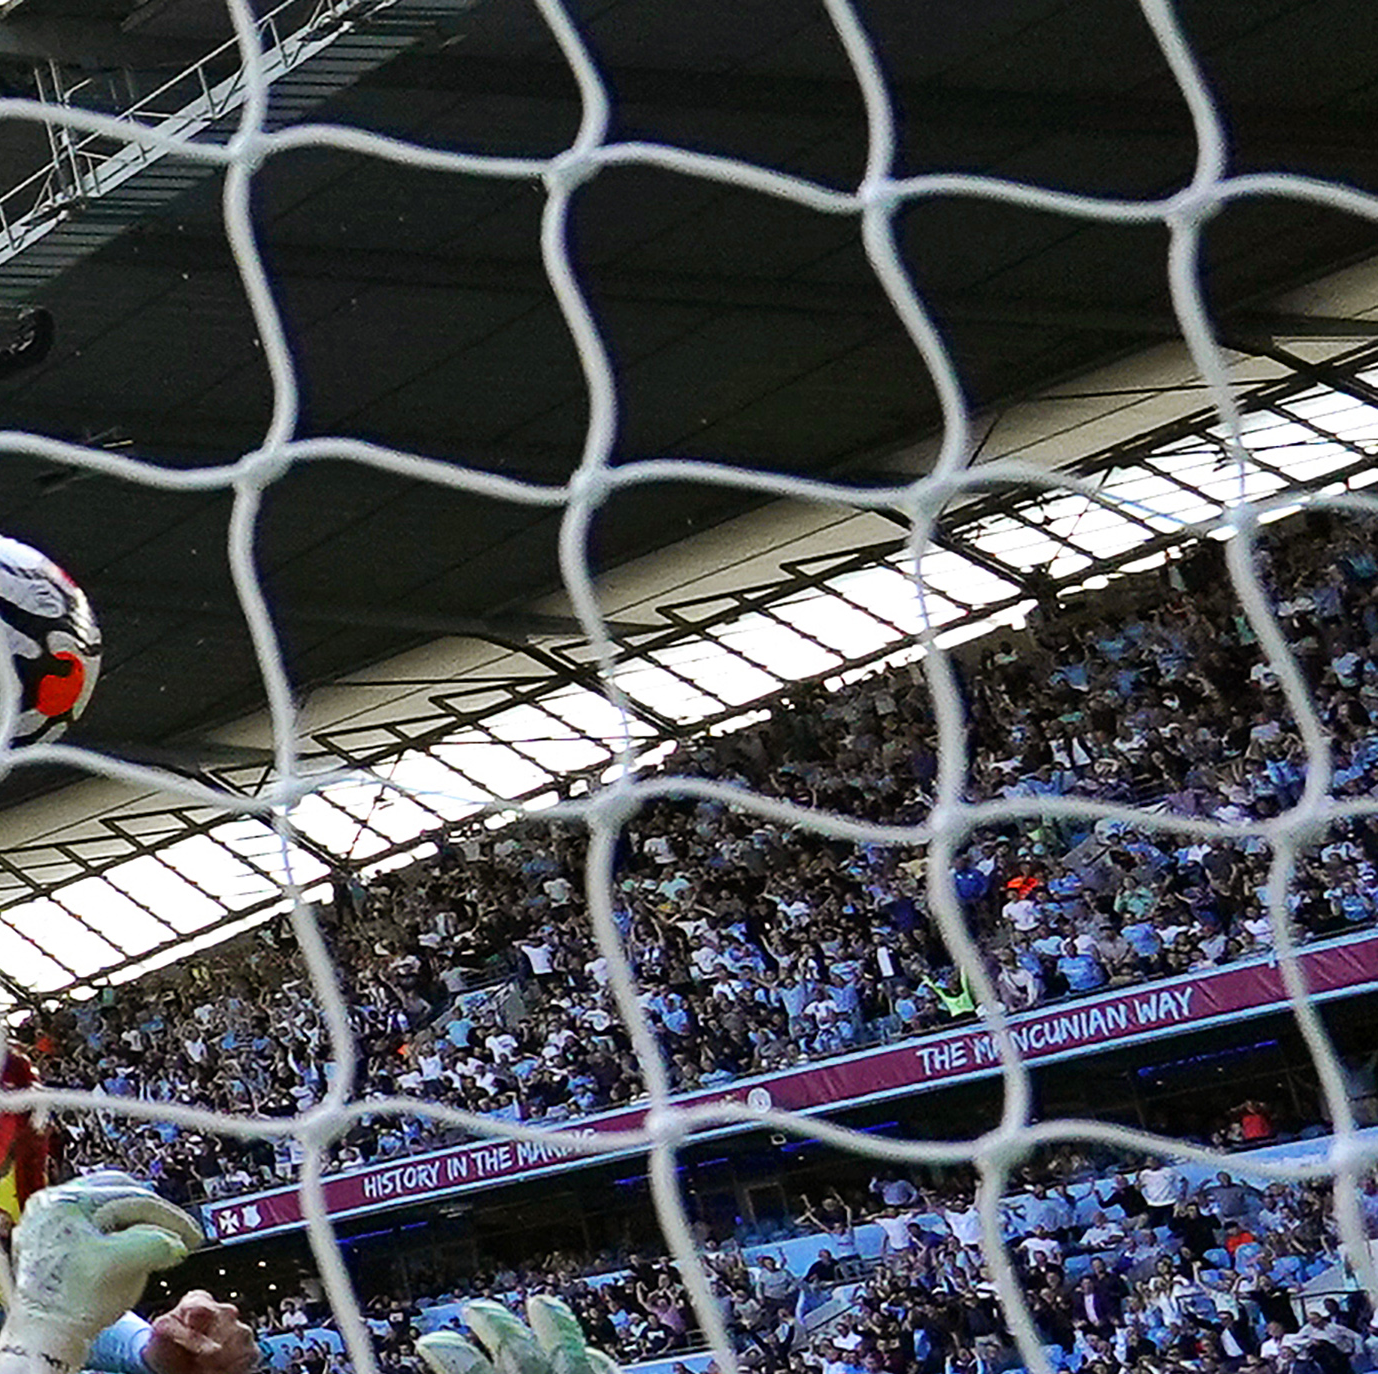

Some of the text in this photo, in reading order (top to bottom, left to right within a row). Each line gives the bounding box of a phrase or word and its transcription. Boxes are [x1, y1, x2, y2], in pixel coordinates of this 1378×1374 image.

[916, 986, 1194, 1076] THE MNCUNIAN WAY
[363, 1160, 441, 1198] HISTORY
[447, 1156, 468, 1181] IN
[470, 1147, 513, 1177] THE
